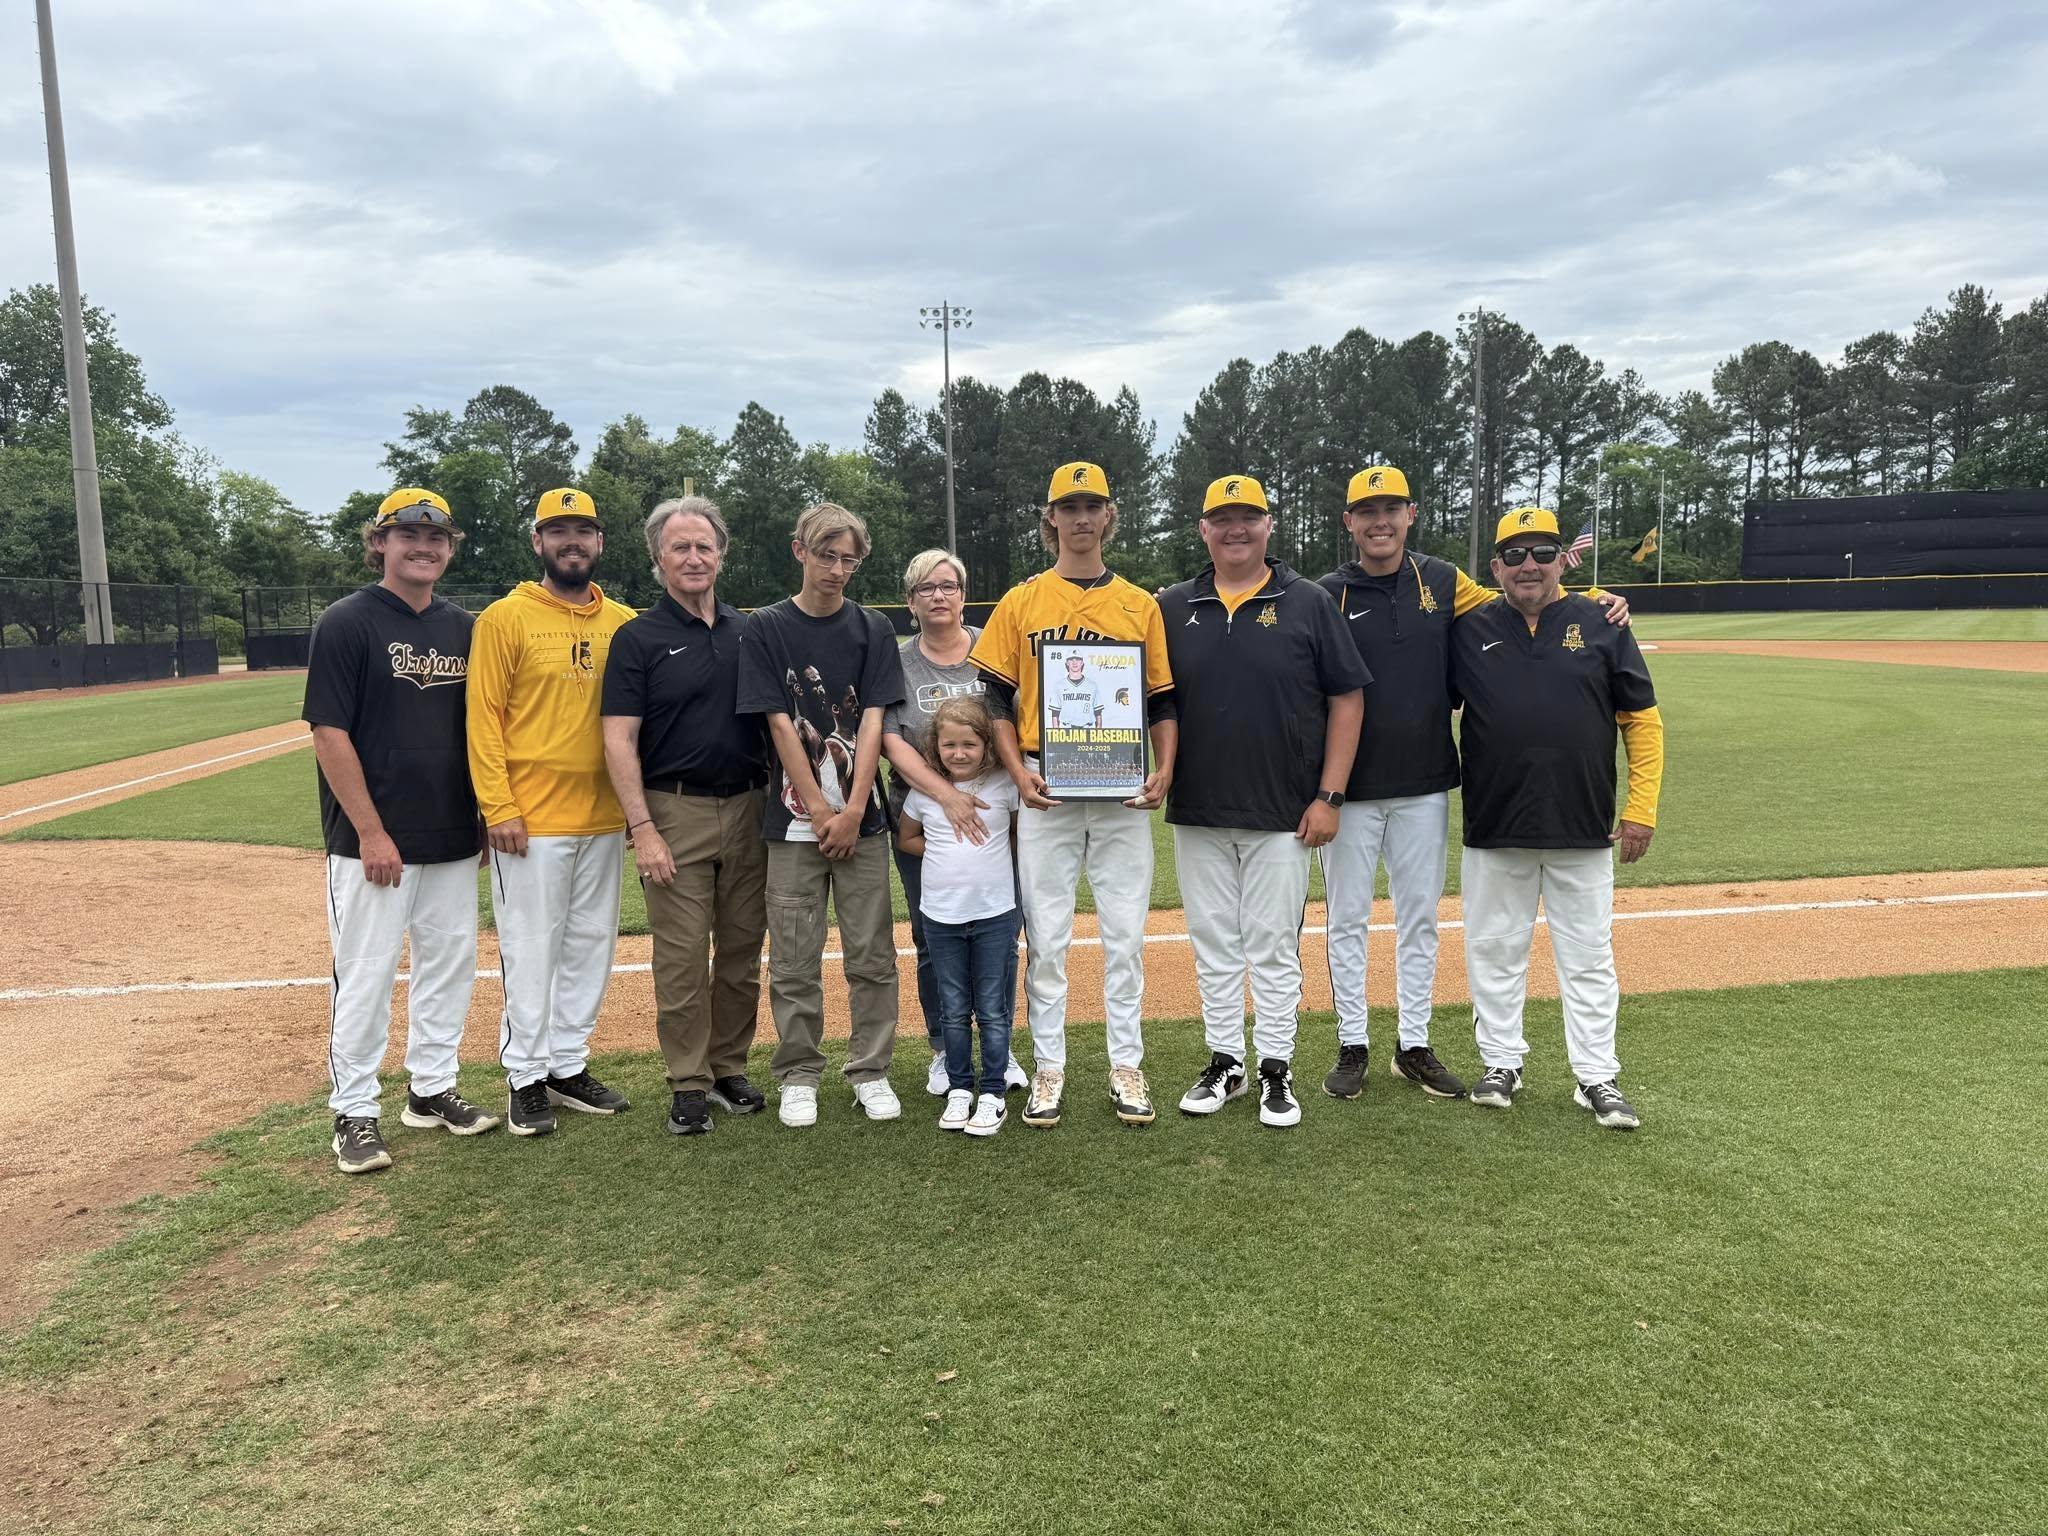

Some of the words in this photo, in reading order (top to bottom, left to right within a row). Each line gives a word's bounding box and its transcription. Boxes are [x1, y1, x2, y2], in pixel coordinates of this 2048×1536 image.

[531, 631, 596, 640] FAYETTEVLLE
[1050, 652, 1062, 660] #8
[1088, 655, 1136, 666] TAKODA
[388, 642, 468, 684] Trojans
[562, 672, 603, 680] BASBALL
[1046, 729, 1087, 743] TROJAN
[1089, 729, 1142, 743] BASEBALL
